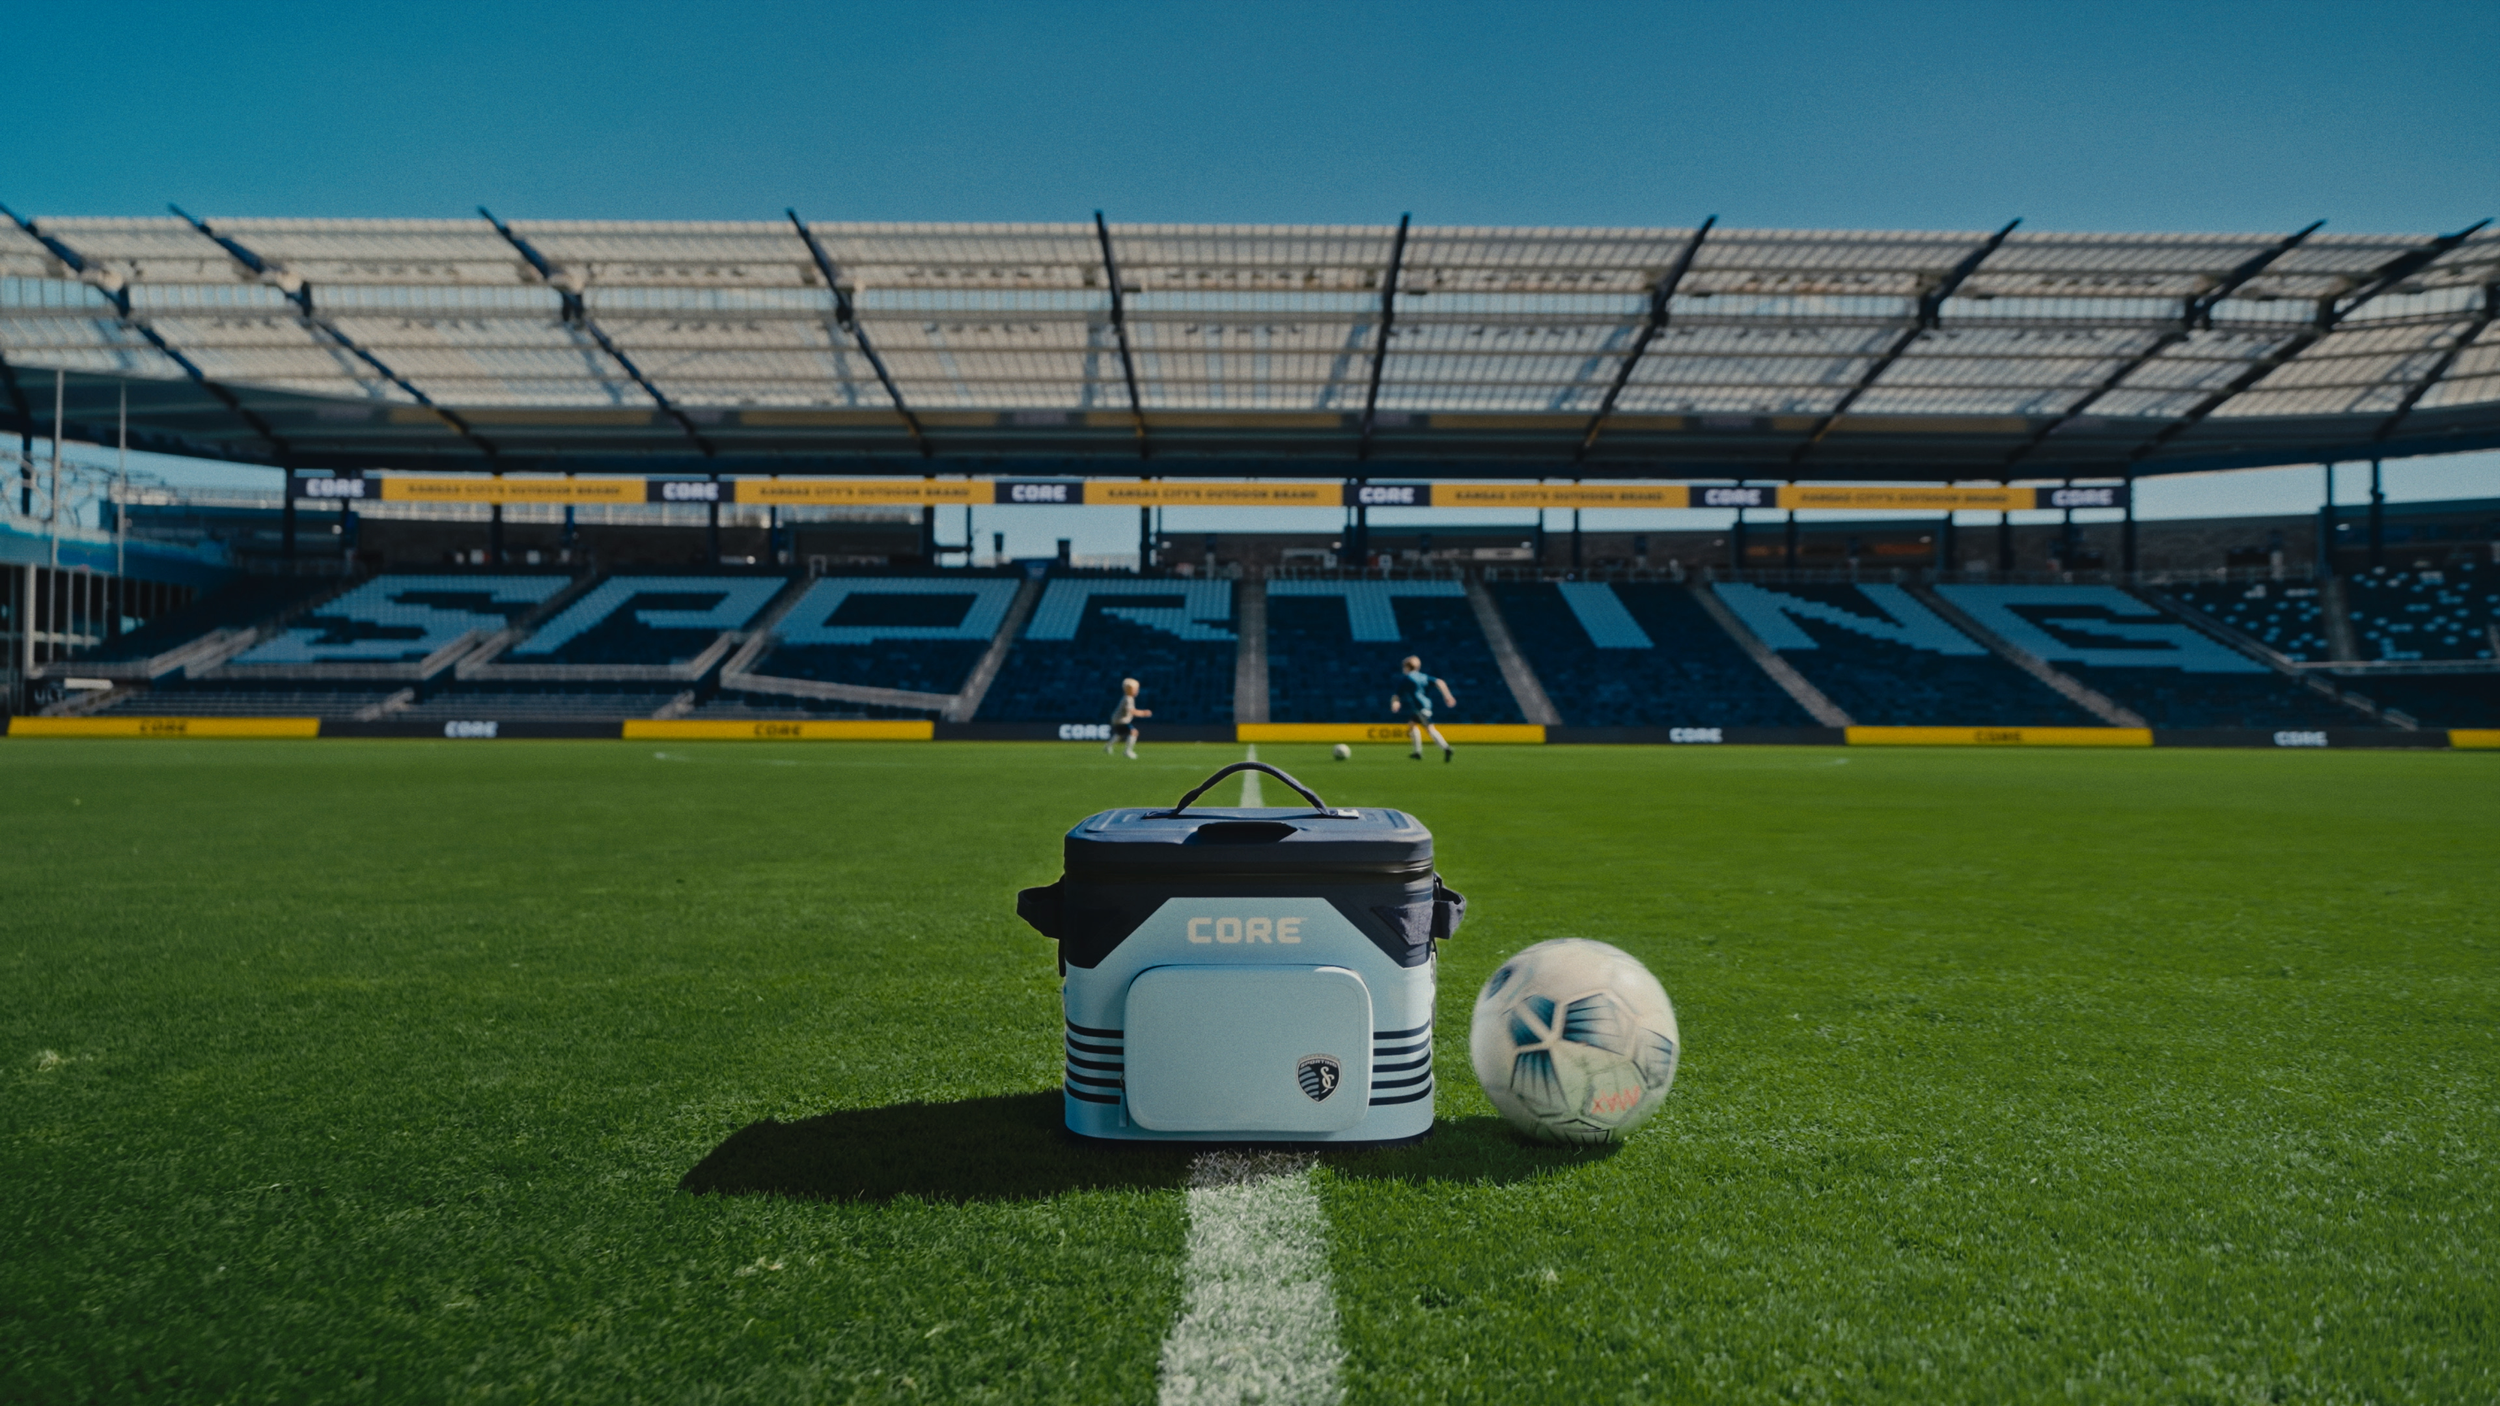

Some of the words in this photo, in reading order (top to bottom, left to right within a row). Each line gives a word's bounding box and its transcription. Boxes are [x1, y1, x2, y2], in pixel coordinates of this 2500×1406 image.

[306, 479, 364, 498] CORE
[663, 482, 718, 500] CORE
[1011, 484, 1066, 502] CORE
[1359, 487, 1414, 503] CORE
[1705, 489, 1760, 506] CORE
[2052, 489, 2112, 506] CORE
[230, 575, 2273, 673] SPORTING
[444, 720, 498, 738] CORE
[753, 723, 803, 737] CORE
[1059, 724, 1111, 740] CORE
[1669, 727, 1722, 743] CORE
[2274, 730, 2328, 746] CORE
[1187, 917, 1308, 943] CORE
